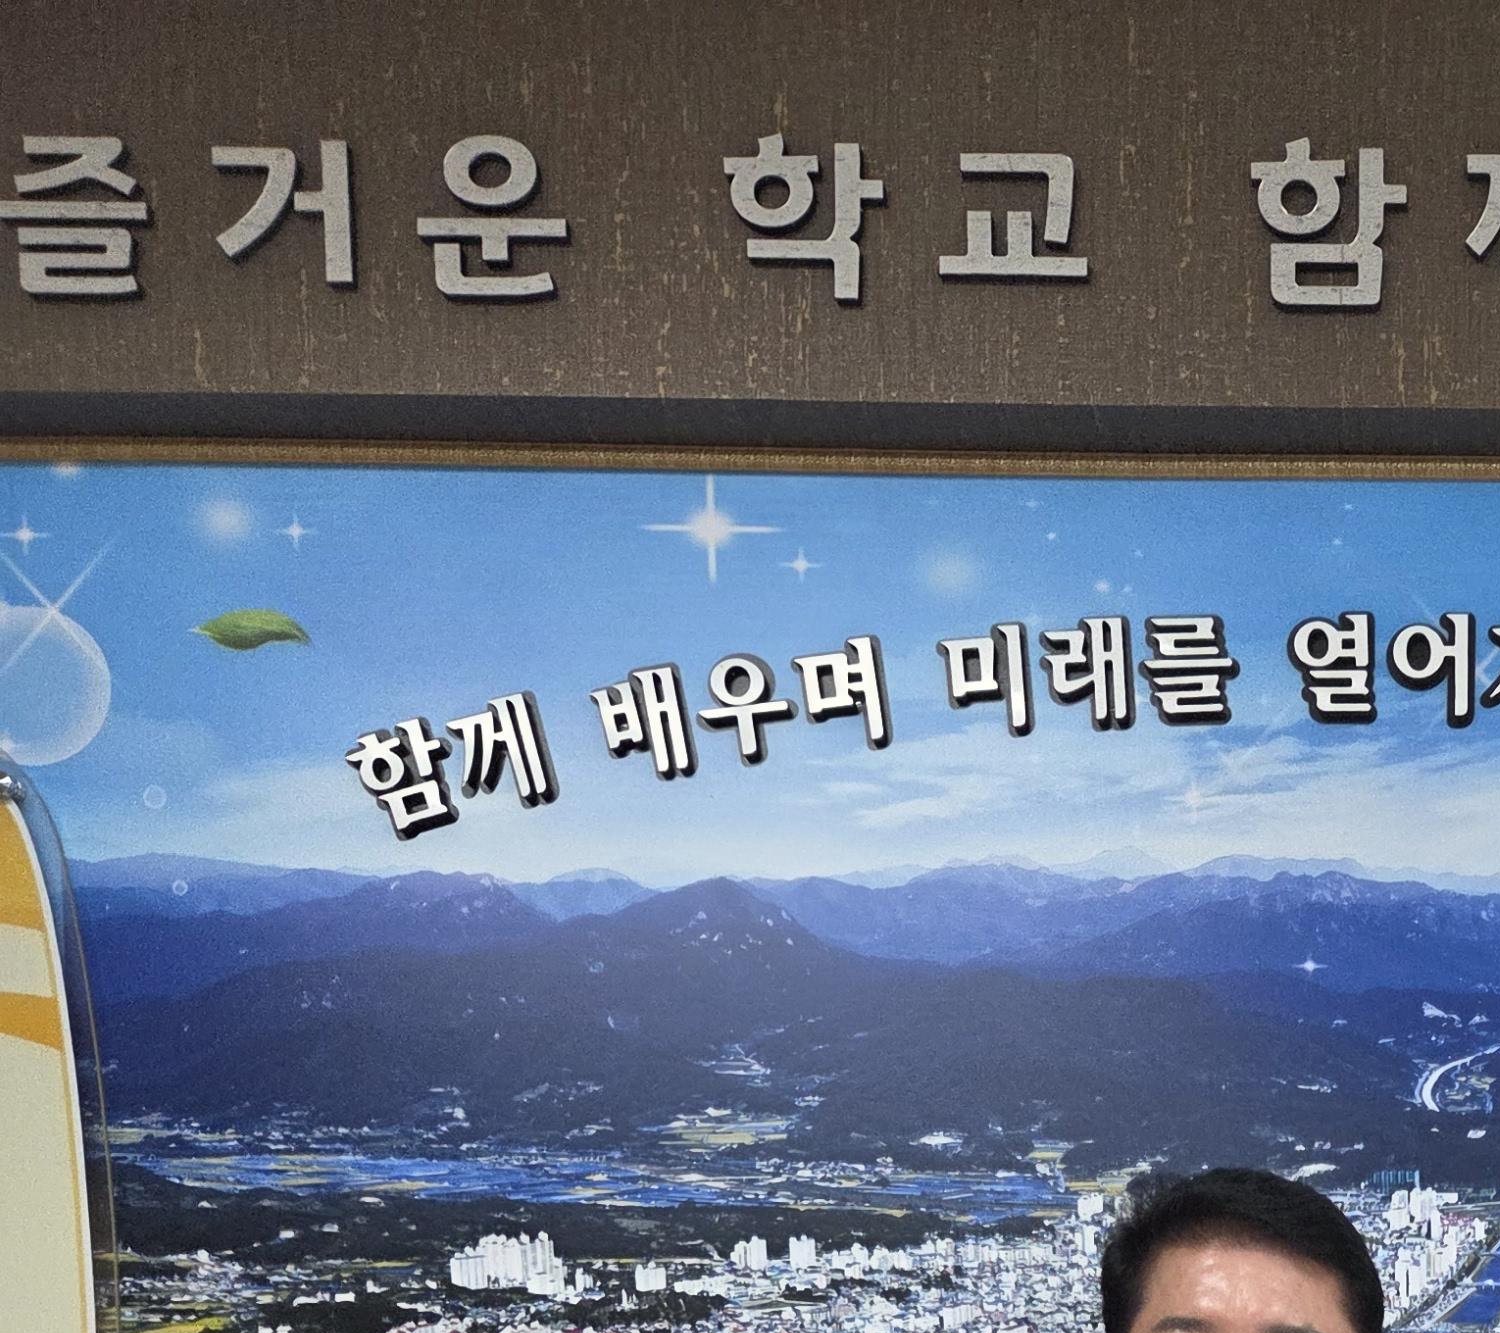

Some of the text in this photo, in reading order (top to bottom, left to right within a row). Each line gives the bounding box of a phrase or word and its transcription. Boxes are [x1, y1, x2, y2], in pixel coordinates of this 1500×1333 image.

[0, 134, 568, 297] 즐거운
[723, 133, 1089, 300] 학교
[345, 690, 560, 841] 함께
[590, 634, 894, 781] 배우며
[938, 614, 1239, 737] 미래를
